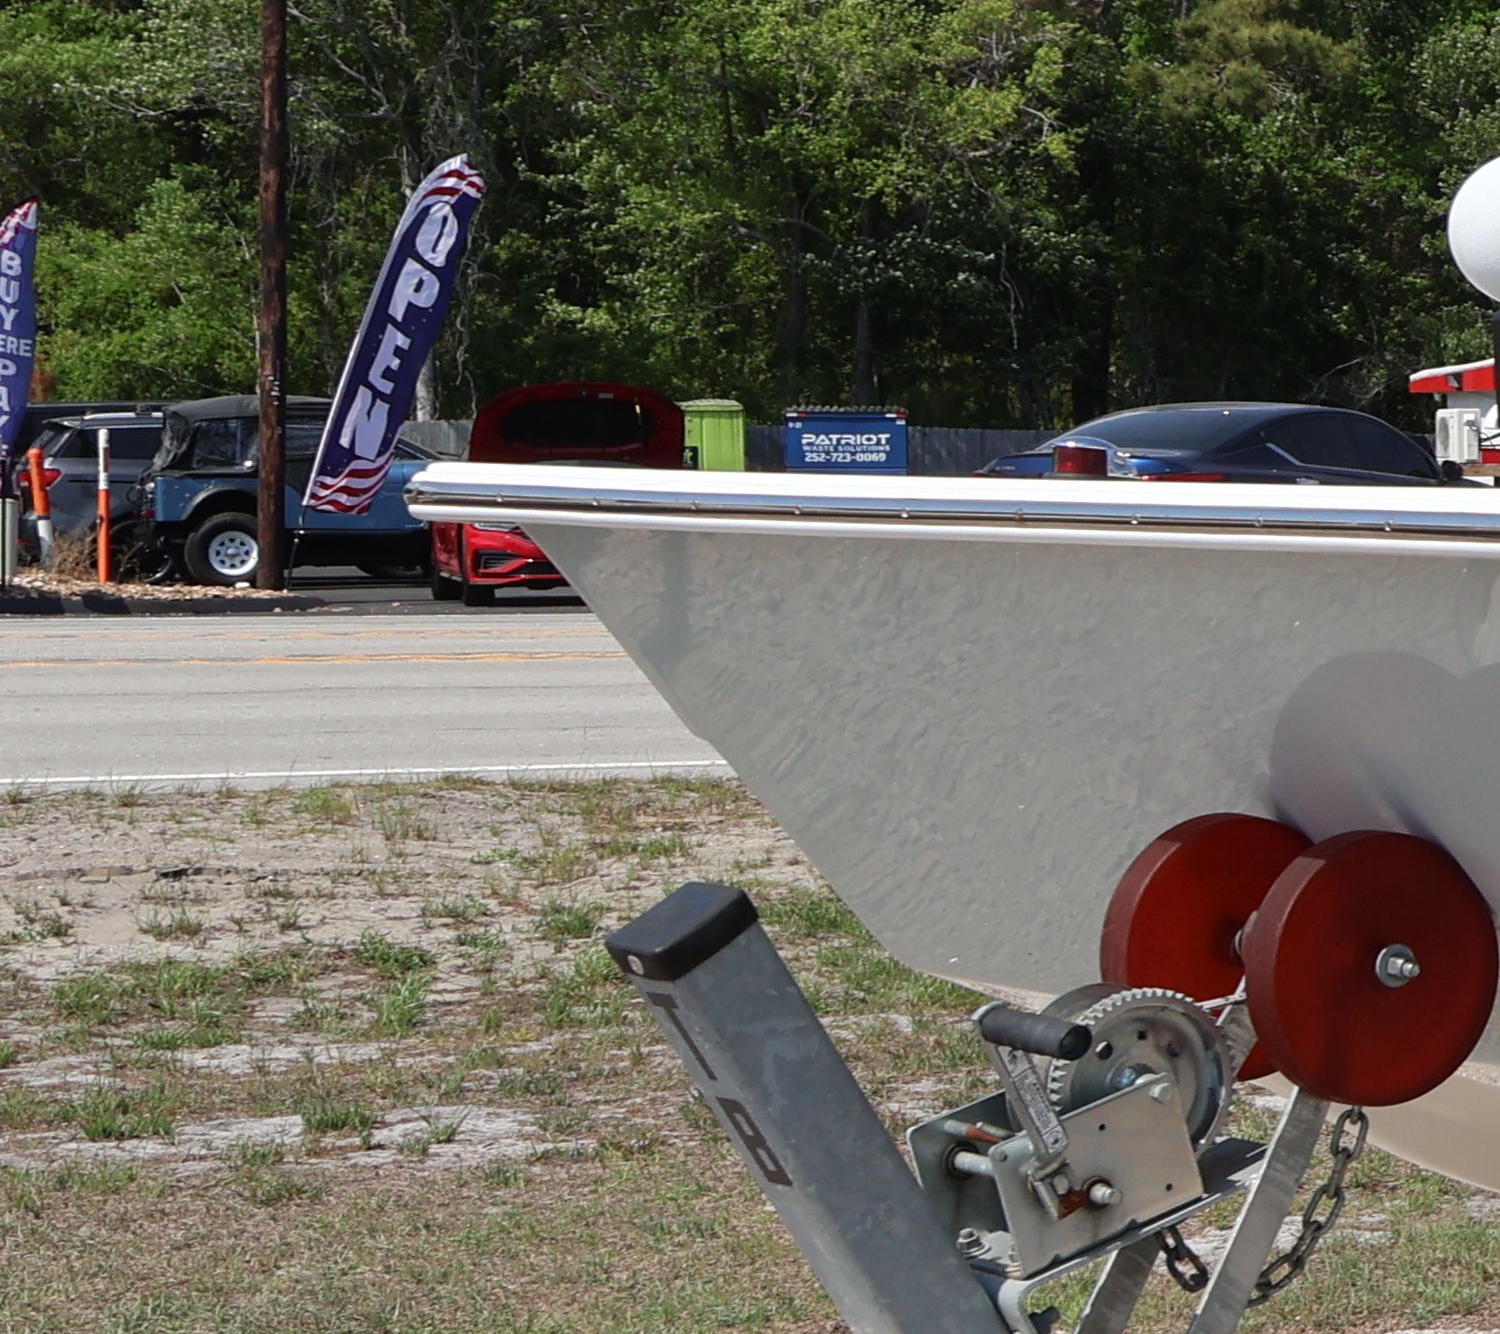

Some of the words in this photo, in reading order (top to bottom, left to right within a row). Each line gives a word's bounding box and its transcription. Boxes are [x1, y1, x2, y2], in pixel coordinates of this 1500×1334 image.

[0, 249, 22, 331] BUY
[338, 200, 458, 461] OPEN
[801, 433, 891, 445] PATRIOT
[804, 452, 887, 462] 252-723-0069
